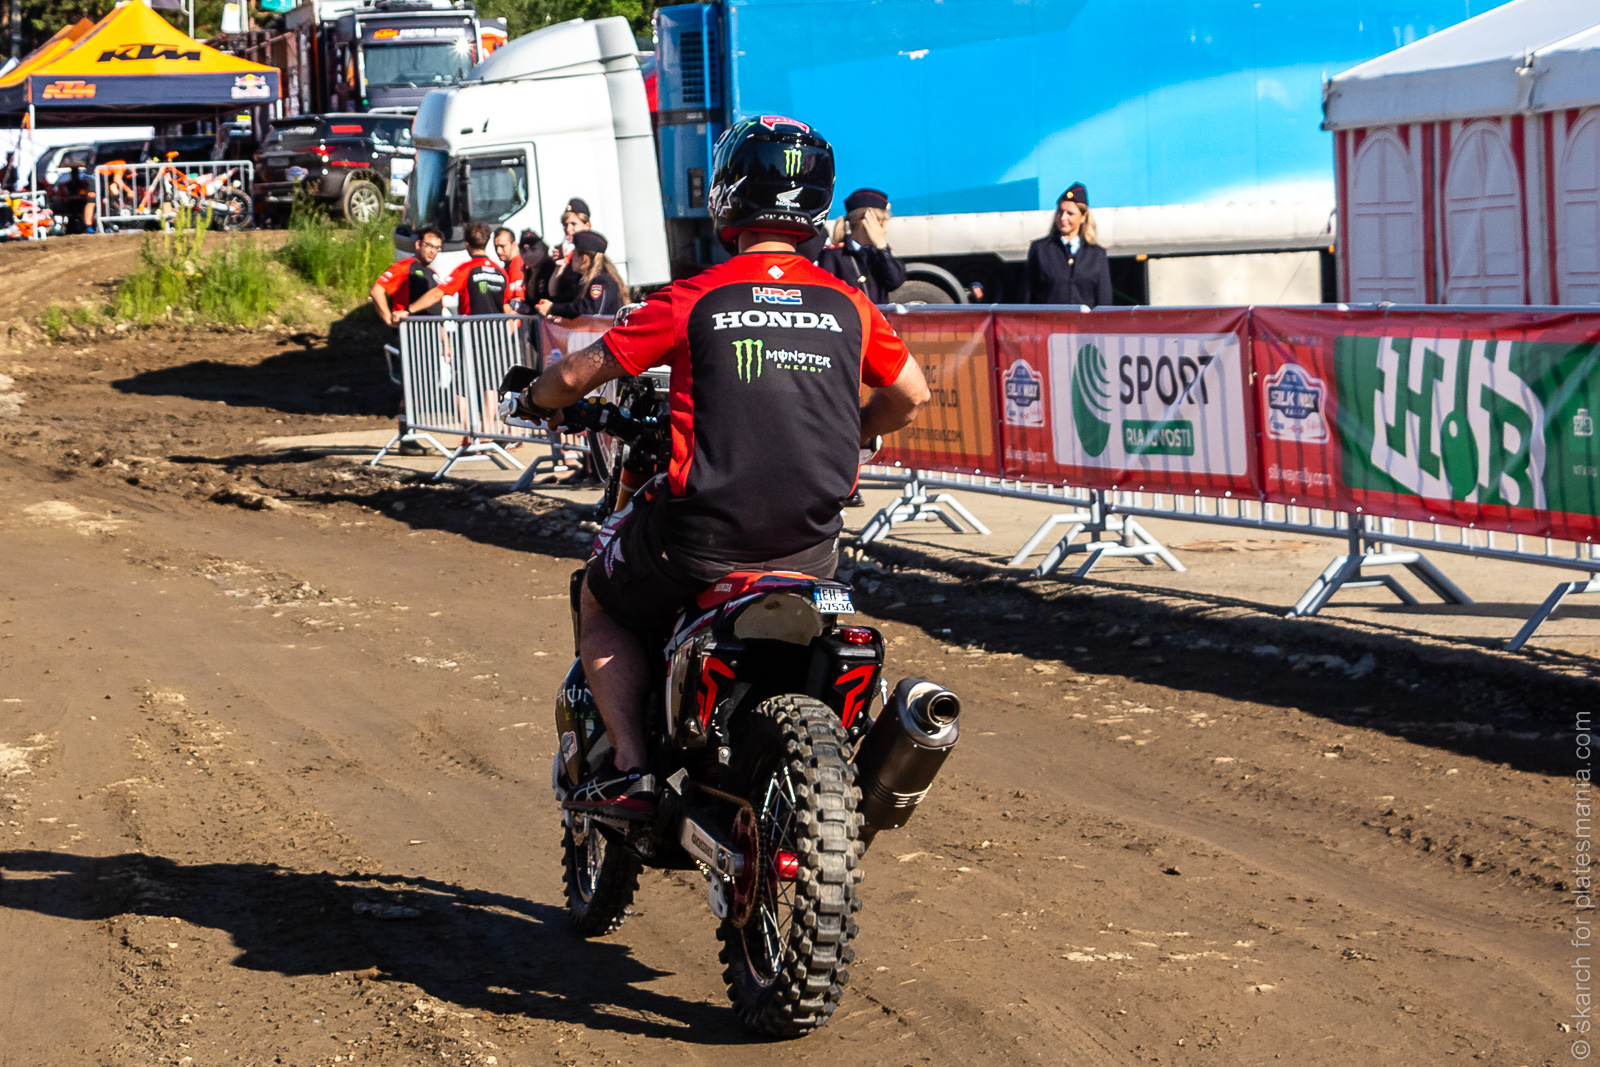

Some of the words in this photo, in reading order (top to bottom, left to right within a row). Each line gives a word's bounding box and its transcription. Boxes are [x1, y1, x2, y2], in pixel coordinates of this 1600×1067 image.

[96, 43, 201, 62] KTM
[42, 80, 97, 99] KTM
[752, 287, 803, 305] HRC
[712, 310, 843, 333] HONDA
[776, 363, 823, 373] ENERGY
[1119, 354, 1215, 406] SPORT
[1007, 382, 1022, 397] SILK
[1270, 390, 1295, 407] SILK
[1297, 392, 1319, 408] WAY
[1126, 428, 1144, 446] RIA
[713, 583, 733, 593] HONDA
